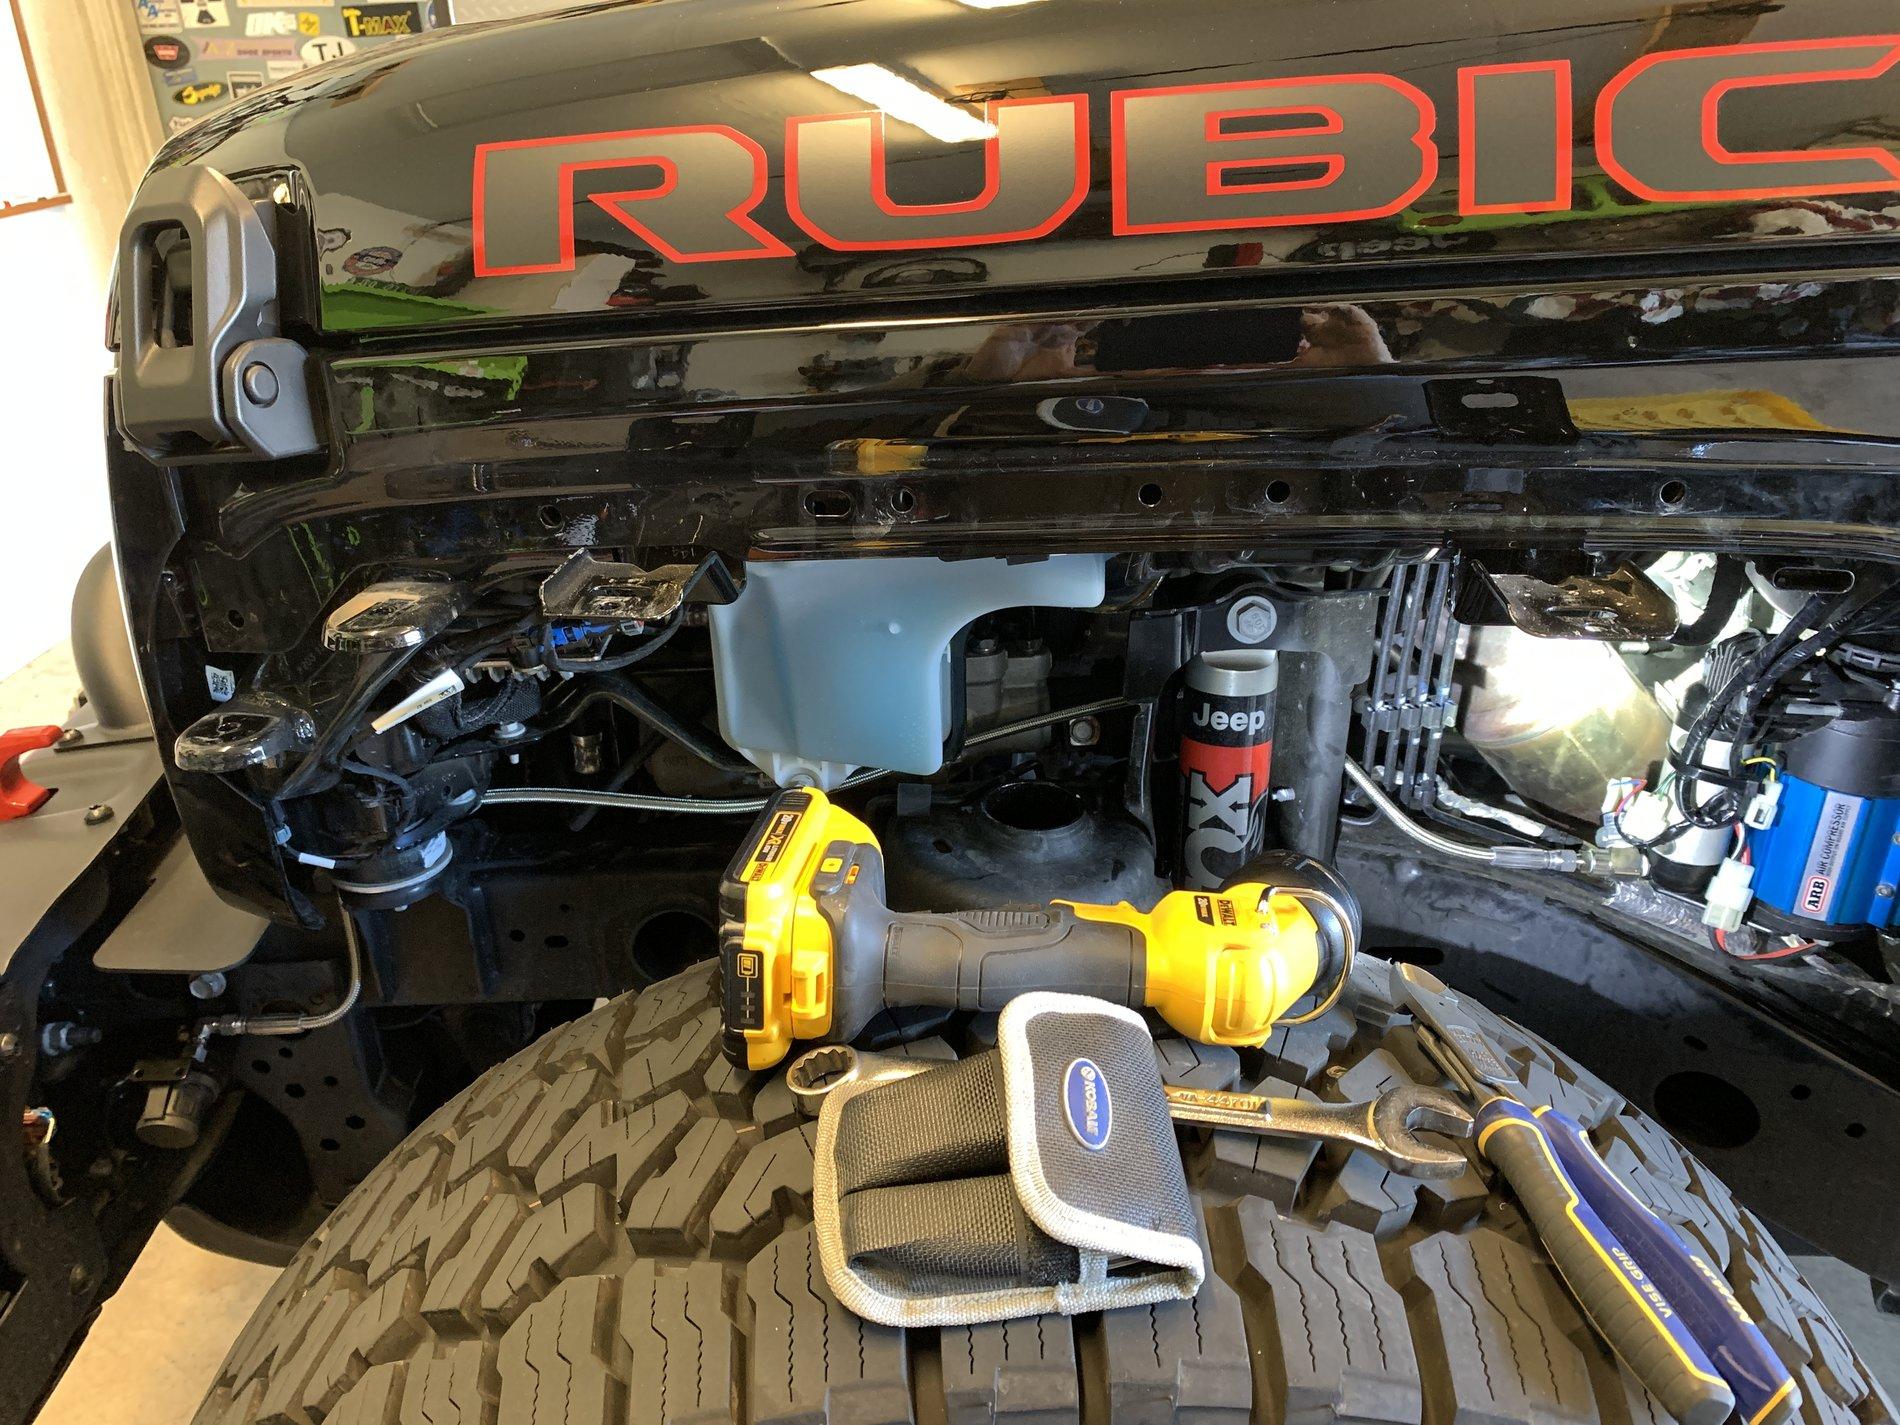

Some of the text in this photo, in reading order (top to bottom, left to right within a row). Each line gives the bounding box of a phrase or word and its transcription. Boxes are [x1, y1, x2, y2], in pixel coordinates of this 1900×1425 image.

[342, 8, 411, 36] T-MAX
[473, 34, 1900, 277] RUBIC
[1193, 702, 1266, 735] Jeep
[1184, 771, 1252, 890] OX
[1815, 803, 1846, 875] AIR COMPRESSOR
[1808, 881, 1825, 908] ARB
[1084, 1080, 1099, 1136] KOBALT
